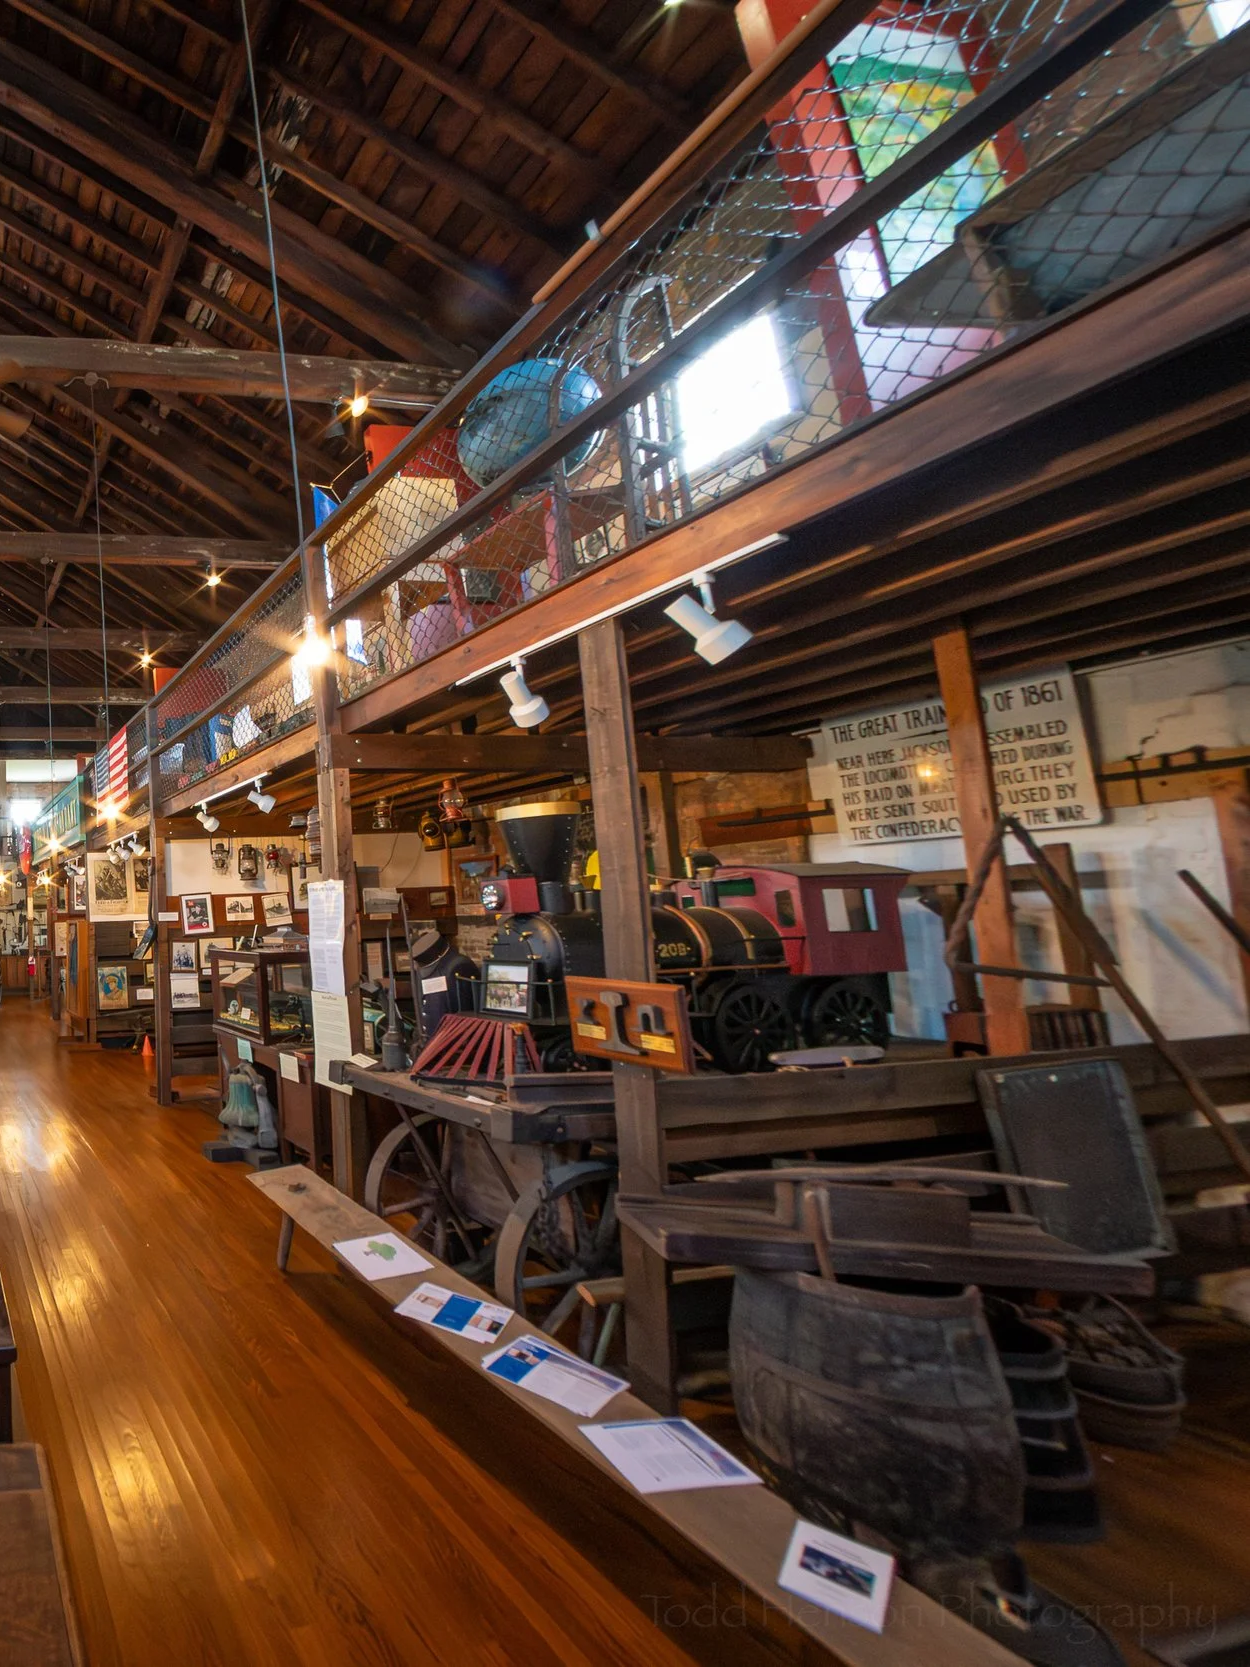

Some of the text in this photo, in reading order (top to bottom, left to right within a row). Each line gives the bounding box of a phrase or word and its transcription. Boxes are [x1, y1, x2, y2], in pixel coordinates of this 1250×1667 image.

[830, 723, 856, 744] THE
[858, 714, 898, 738] GREAT
[902, 704, 947, 730] TRAIN
[994, 690, 1014, 712] OF
[1021, 681, 1063, 707] 1861
[836, 755, 865, 771] NEAR
[867, 749, 895, 765] HERE
[987, 720, 1067, 746] SSEMBLED
[840, 773, 860, 788] THE
[1021, 740, 1073, 761] DURING
[842, 791, 862, 806] HIS
[864, 786, 893, 802] RAID
[897, 784, 914, 799] ON
[1030, 762, 1075, 781] THEY
[846, 807, 880, 822] WERE
[882, 803, 916, 818] SENT
[922, 798, 956, 814] SOUT
[1007, 786, 1050, 804] USED
[1055, 783, 1078, 800] BY
[851, 826, 873, 840] THE
[1024, 809, 1052, 825] THE
